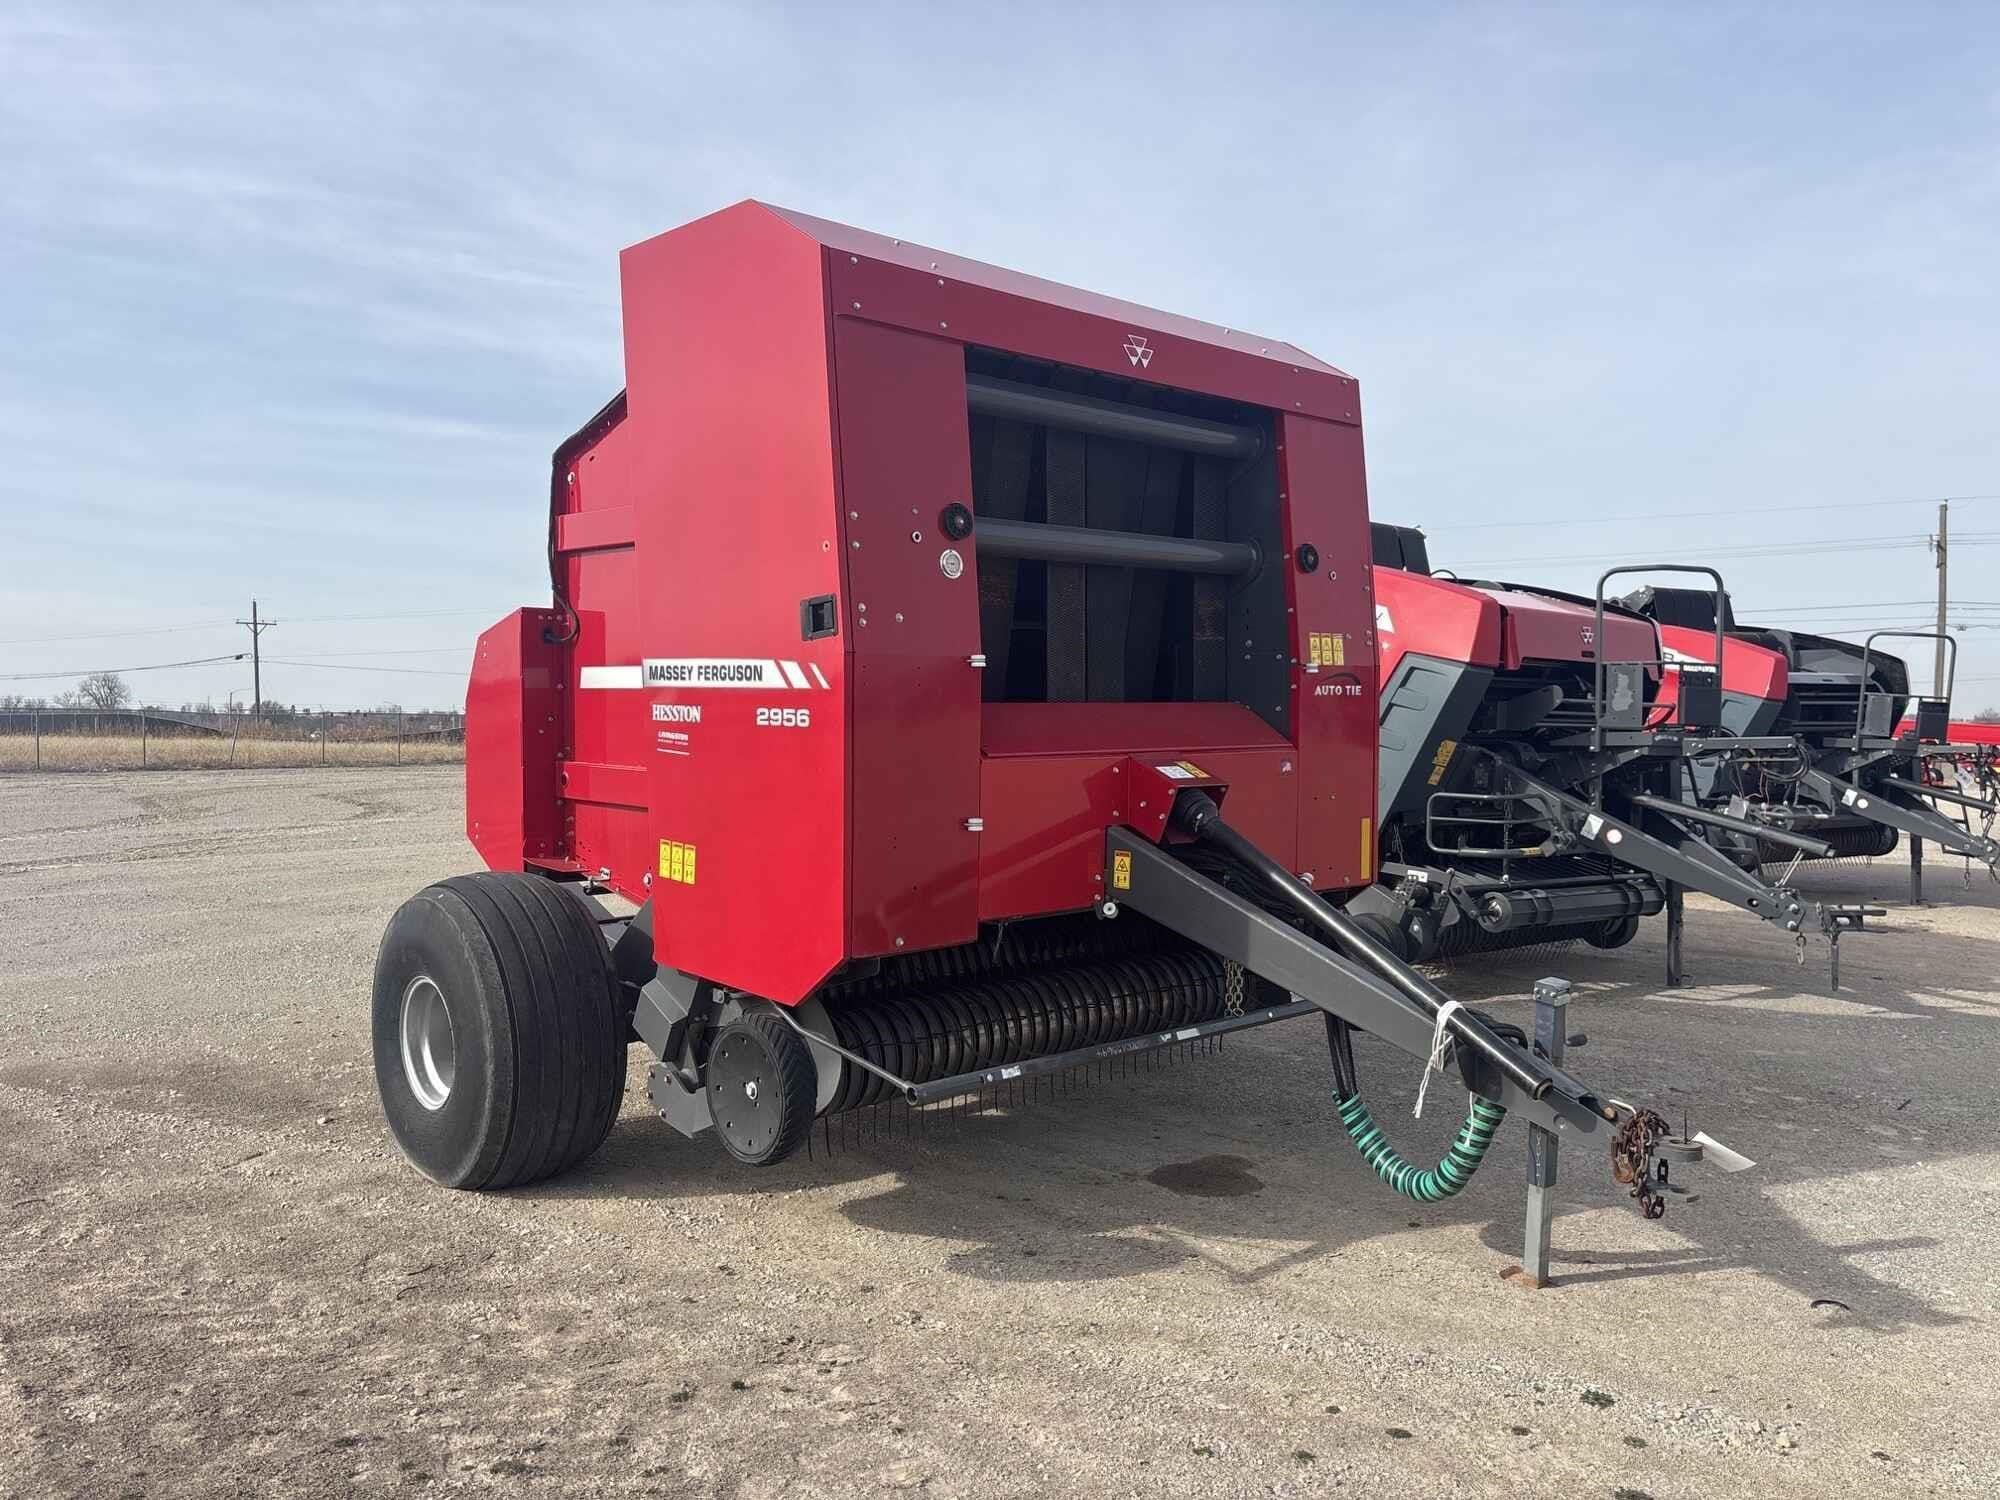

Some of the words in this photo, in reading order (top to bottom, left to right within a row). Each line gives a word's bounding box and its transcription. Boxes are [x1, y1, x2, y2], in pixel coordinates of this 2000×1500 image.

[648, 665, 693, 681] MASSEY
[697, 664, 763, 682] FERGUSON
[1314, 685, 1342, 696] AUTO
[1345, 685, 1362, 696] TIE
[652, 704, 701, 723] HESSTON
[756, 707, 810, 727] 2956
